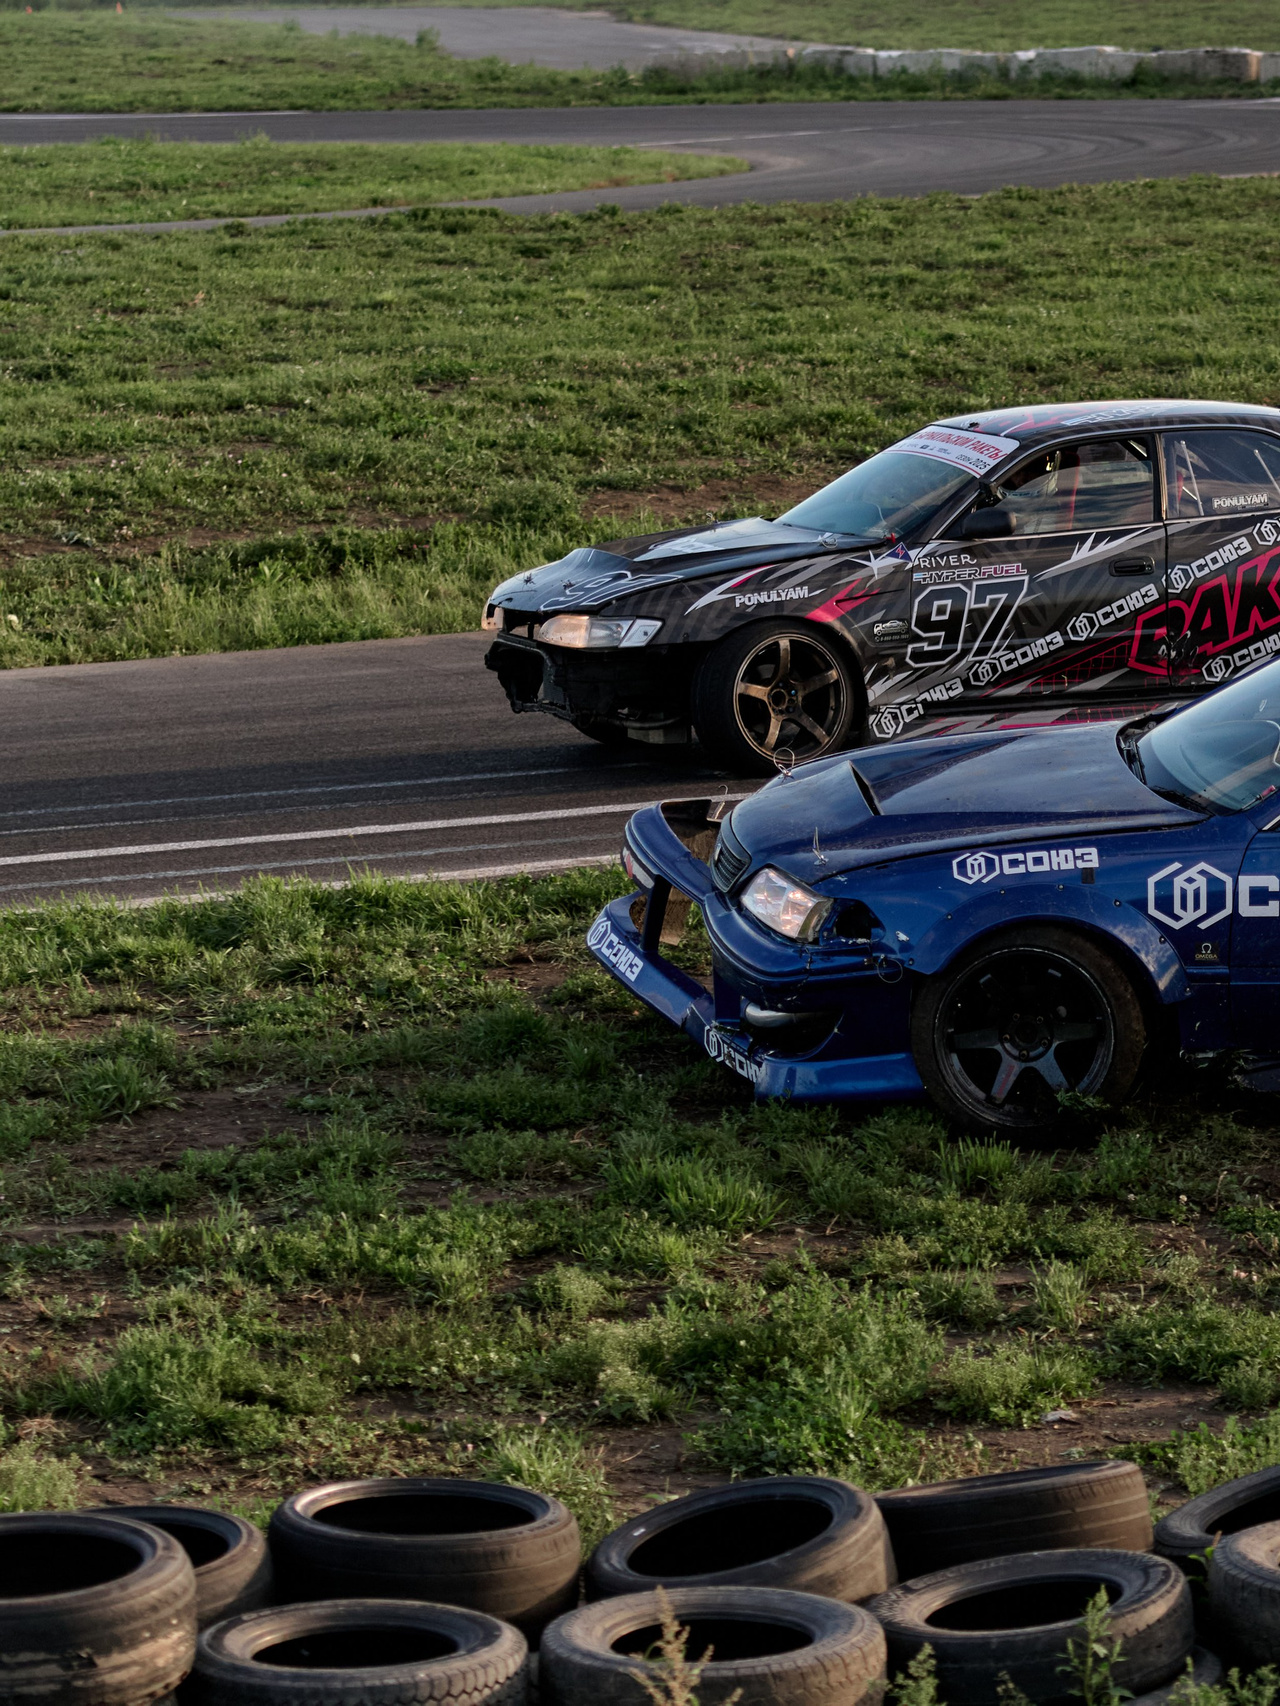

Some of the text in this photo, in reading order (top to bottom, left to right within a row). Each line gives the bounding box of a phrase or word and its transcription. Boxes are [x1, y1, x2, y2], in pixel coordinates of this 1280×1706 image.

[968, 457, 991, 470] 2025
[1214, 493, 1268, 508] PONULYAM
[919, 554, 977, 569] RIVER
[1191, 537, 1253, 578] СОЮЗ
[735, 586, 809, 608] PONULYAM
[1096, 583, 1160, 626] СОЮЗ
[905, 575, 1030, 669] 97
[1000, 631, 1065, 673] СОЮЗ
[1001, 847, 1100, 875] СОЮЗ
[600, 932, 644, 982] СОЮЗ
